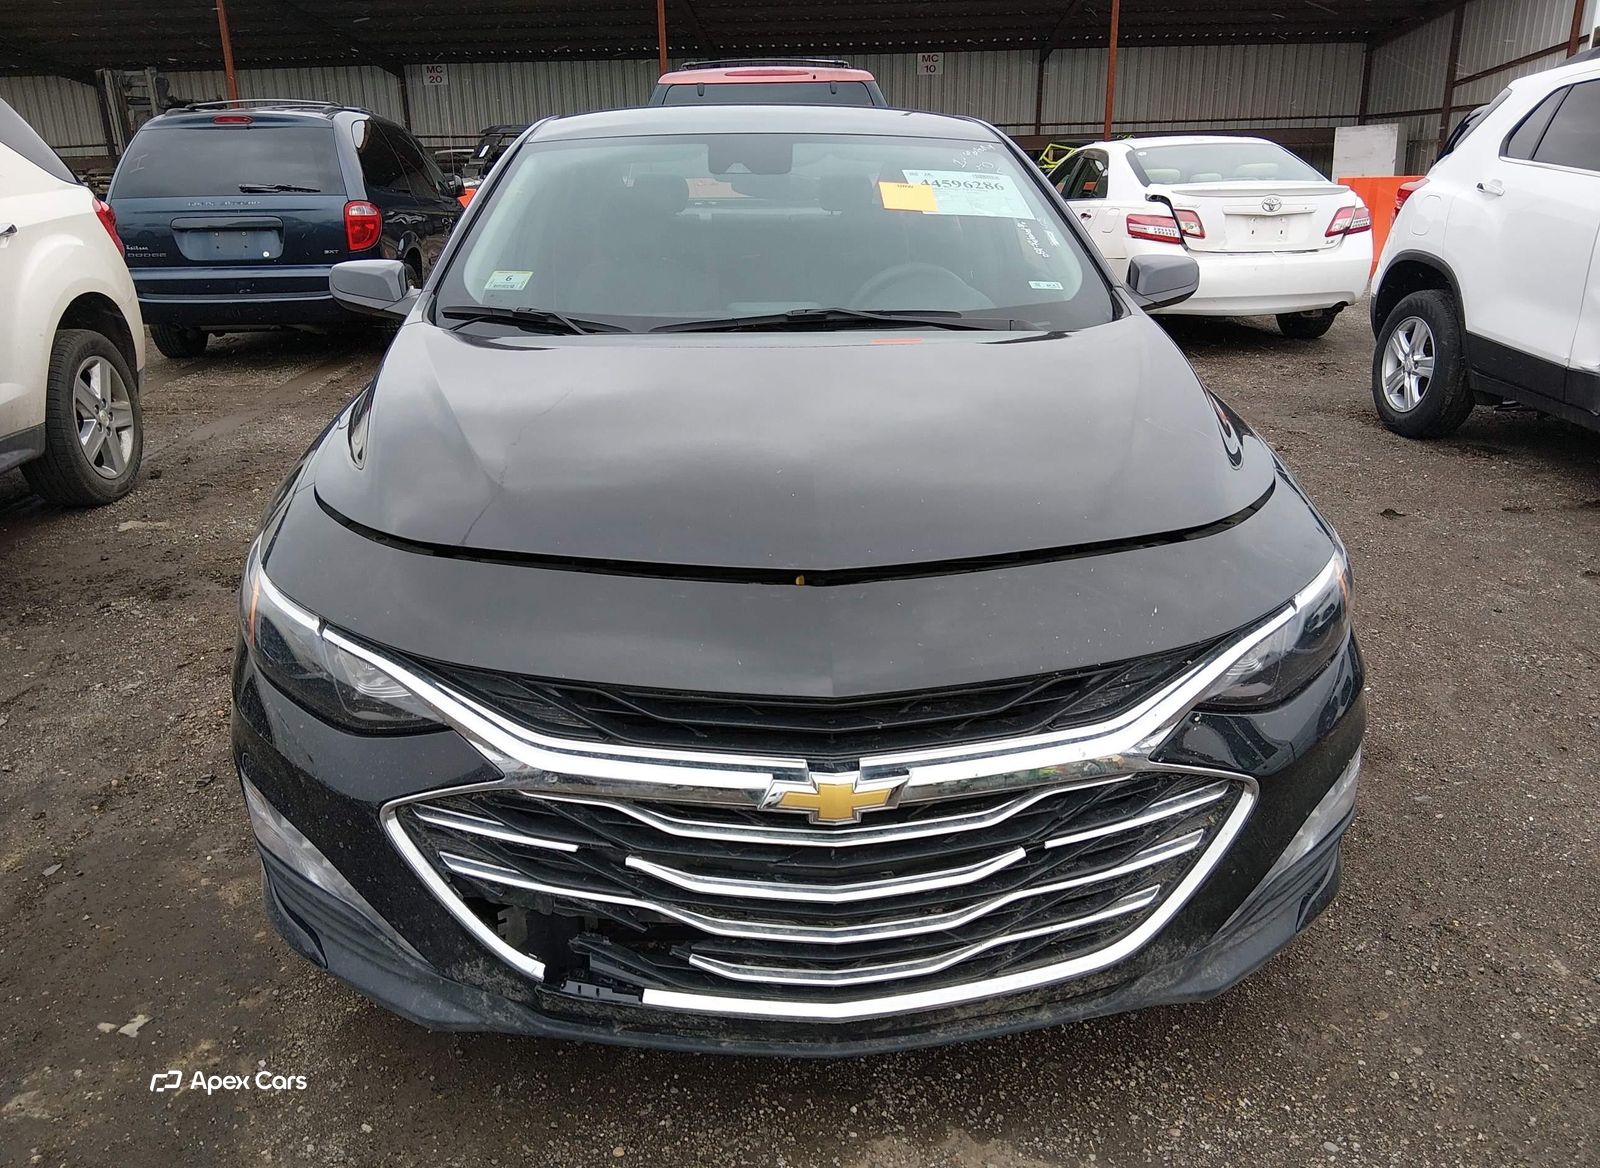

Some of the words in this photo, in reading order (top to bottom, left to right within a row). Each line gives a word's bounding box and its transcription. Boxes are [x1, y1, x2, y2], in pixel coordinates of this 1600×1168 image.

[922, 54, 939, 62] MC
[426, 65, 443, 74] MC
[924, 65, 936, 73] 10
[428, 75, 443, 84] 20
[920, 179, 1005, 192] 44596286
